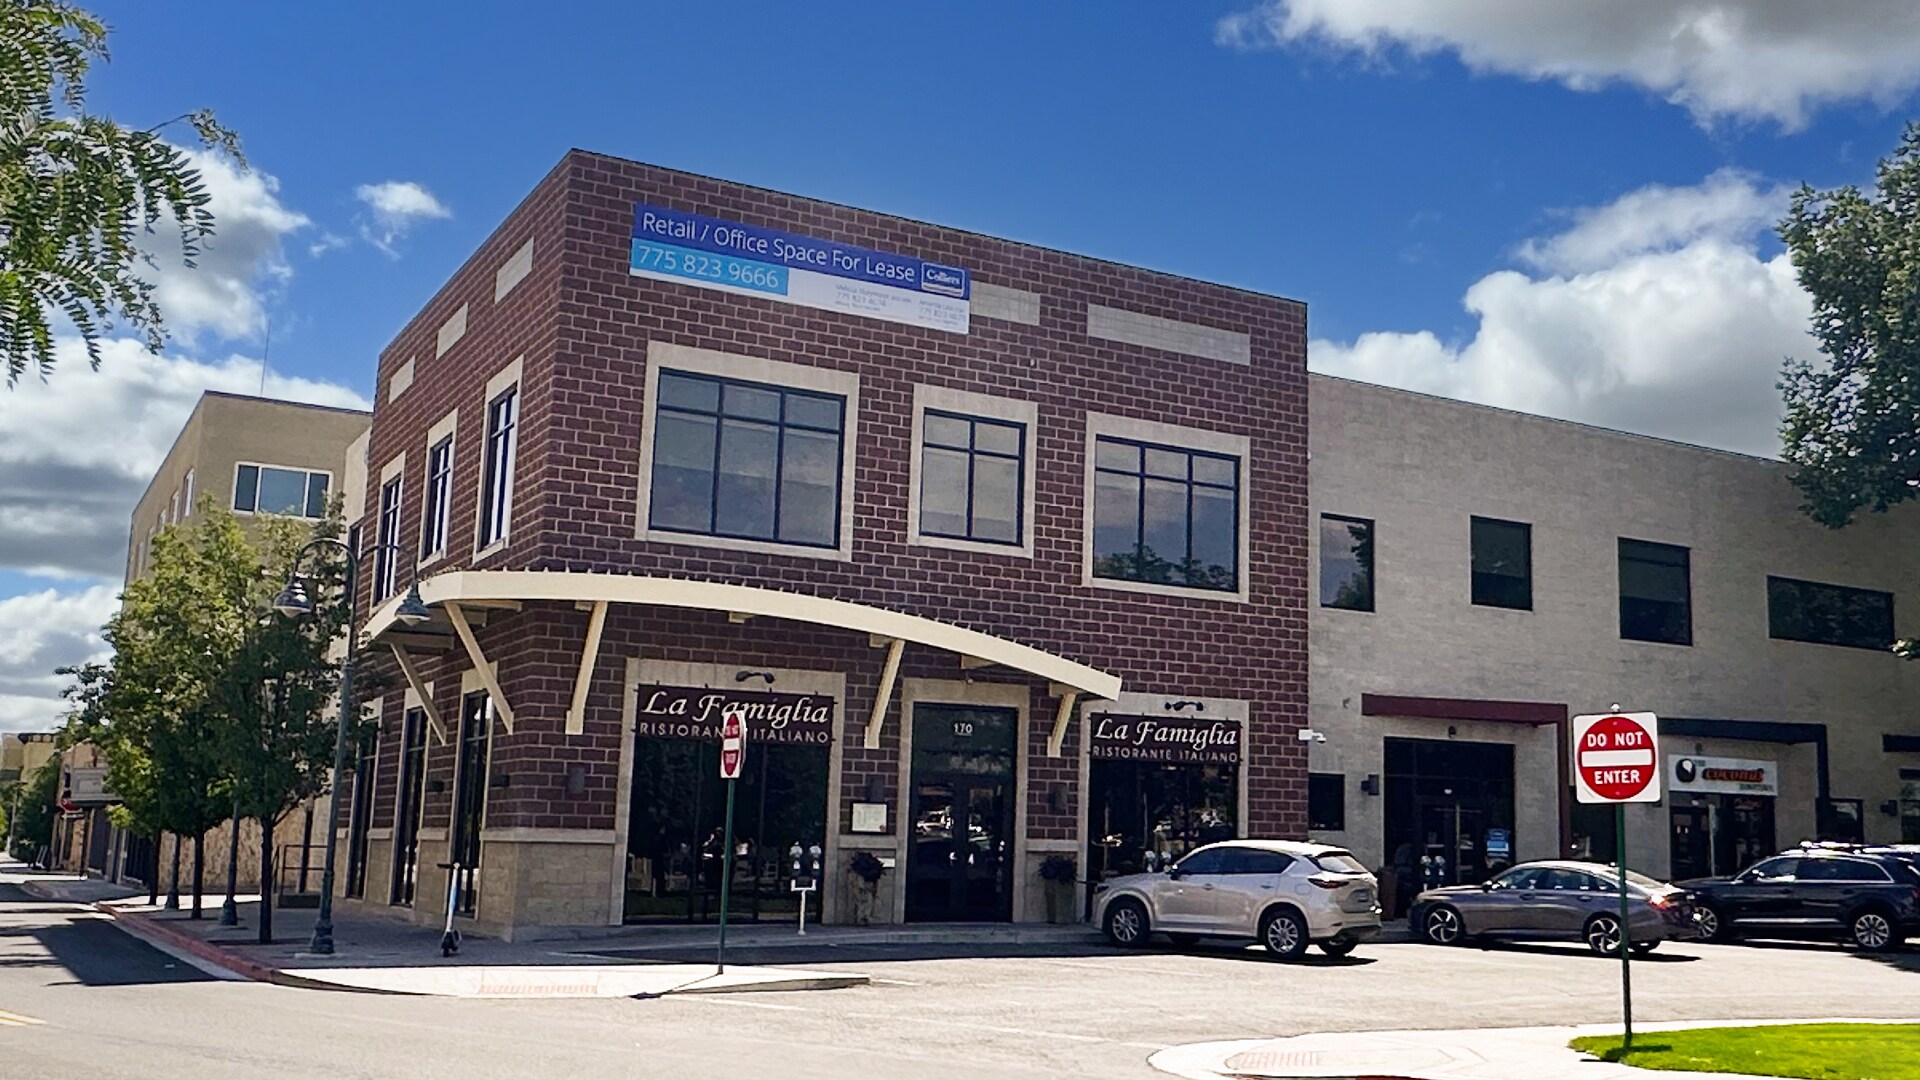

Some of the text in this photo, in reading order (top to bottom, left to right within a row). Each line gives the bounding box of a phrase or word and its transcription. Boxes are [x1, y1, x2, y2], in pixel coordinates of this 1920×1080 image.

[642, 211, 915, 283] Retail / Office Space For Lease
[638, 245, 779, 288] 775 823 9666
[641, 690, 829, 729] La Famiglia
[639, 722, 725, 738] RISTORAN
[752, 729, 829, 744] ITALIANO
[953, 722, 973, 735] 170
[1094, 718, 1237, 751] La Famiglia
[1587, 731, 1644, 748] DO NOT
[1092, 745, 1238, 764] RISTORANTE ITALIANO
[1594, 769, 1641, 785] ENTER
